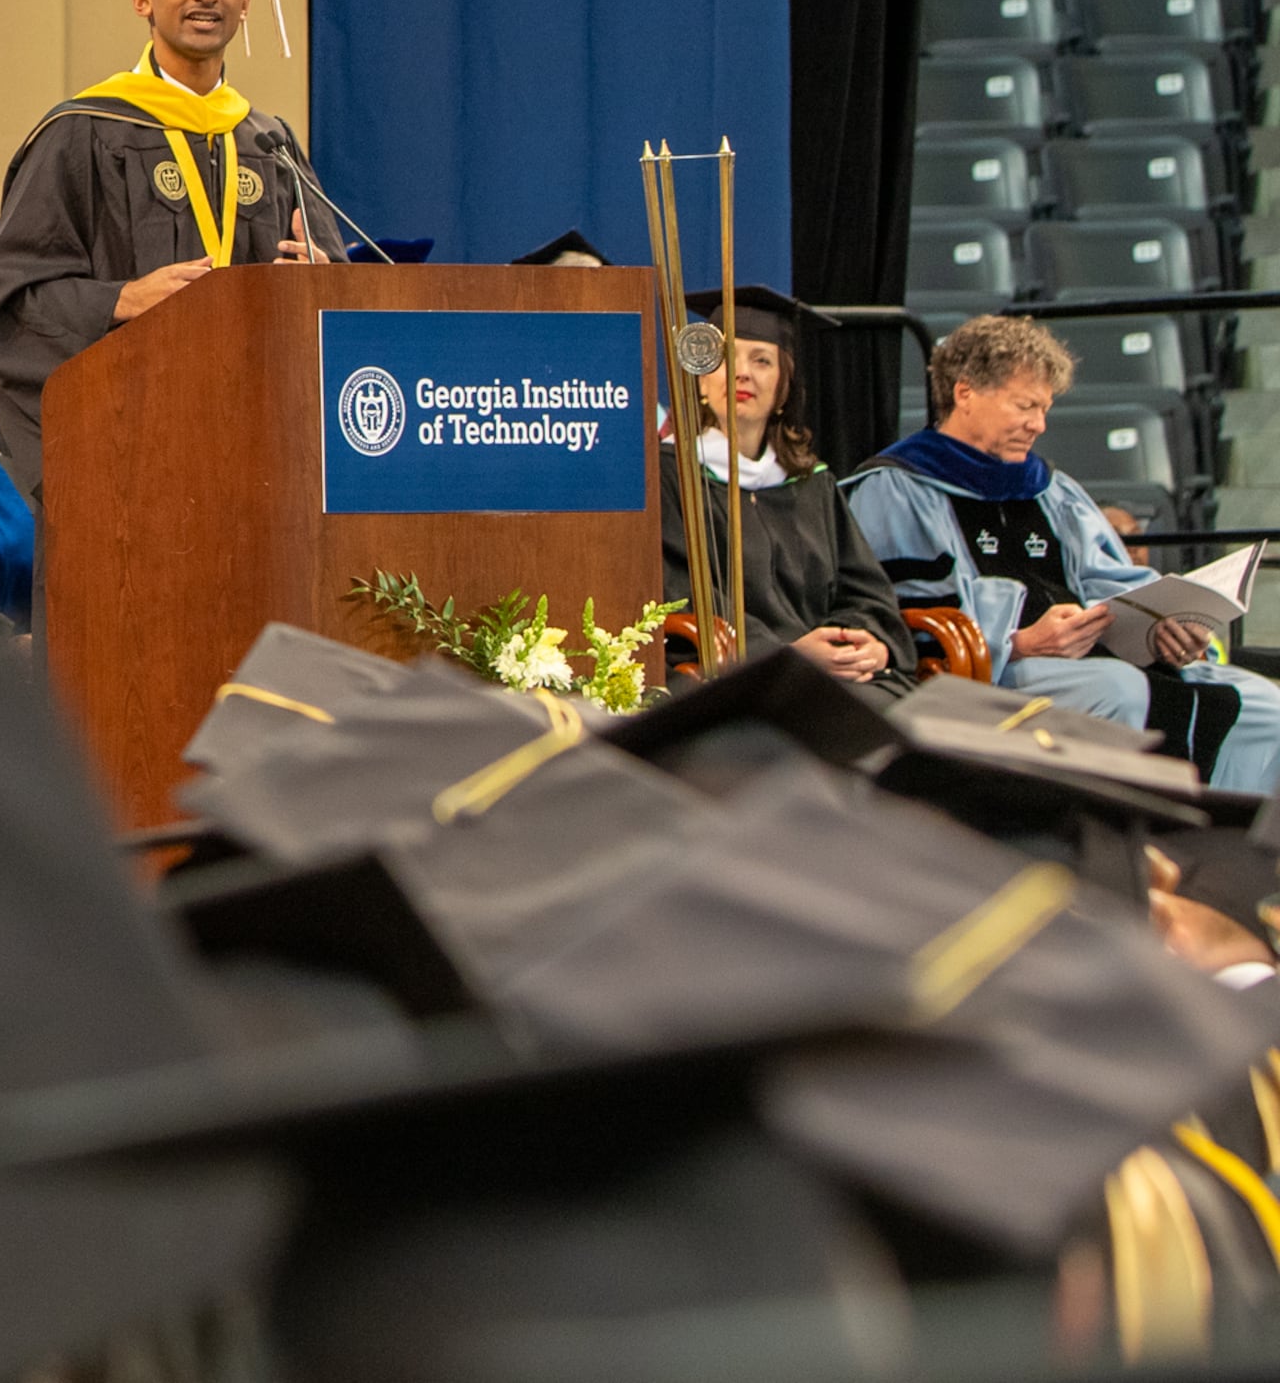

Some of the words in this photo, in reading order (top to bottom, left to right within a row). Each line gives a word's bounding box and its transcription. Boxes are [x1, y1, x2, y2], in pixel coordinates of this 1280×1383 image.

[416, 378, 518, 416] Georgia
[521, 378, 629, 409] Institute
[418, 414, 444, 445] of
